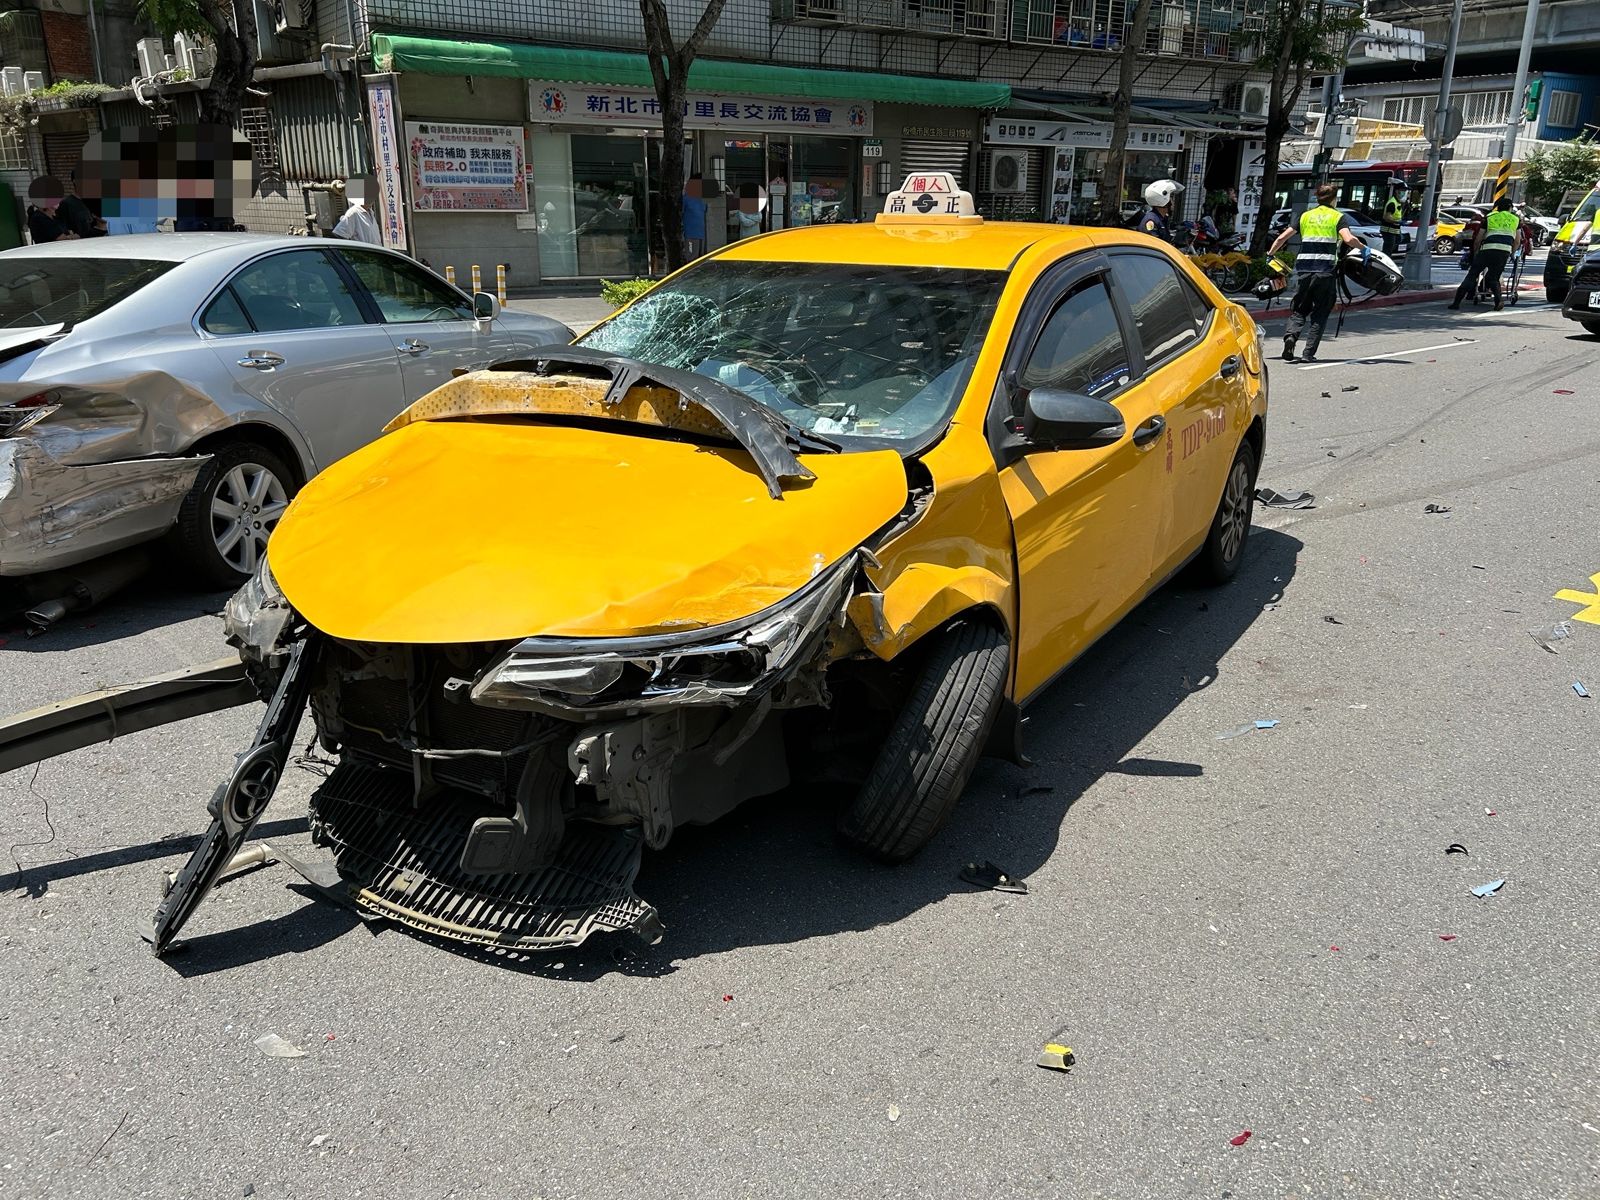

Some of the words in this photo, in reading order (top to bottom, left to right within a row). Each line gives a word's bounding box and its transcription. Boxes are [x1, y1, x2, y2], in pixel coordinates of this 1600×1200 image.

[422, 147, 466, 158] 政府補助
[470, 148, 512, 160] 我來服務
[865, 147, 880, 156] 119
[424, 160, 467, 172] 長照2.0
[912, 177, 943, 192] 個人
[890, 196, 906, 213] 高
[945, 196, 960, 213] 正
